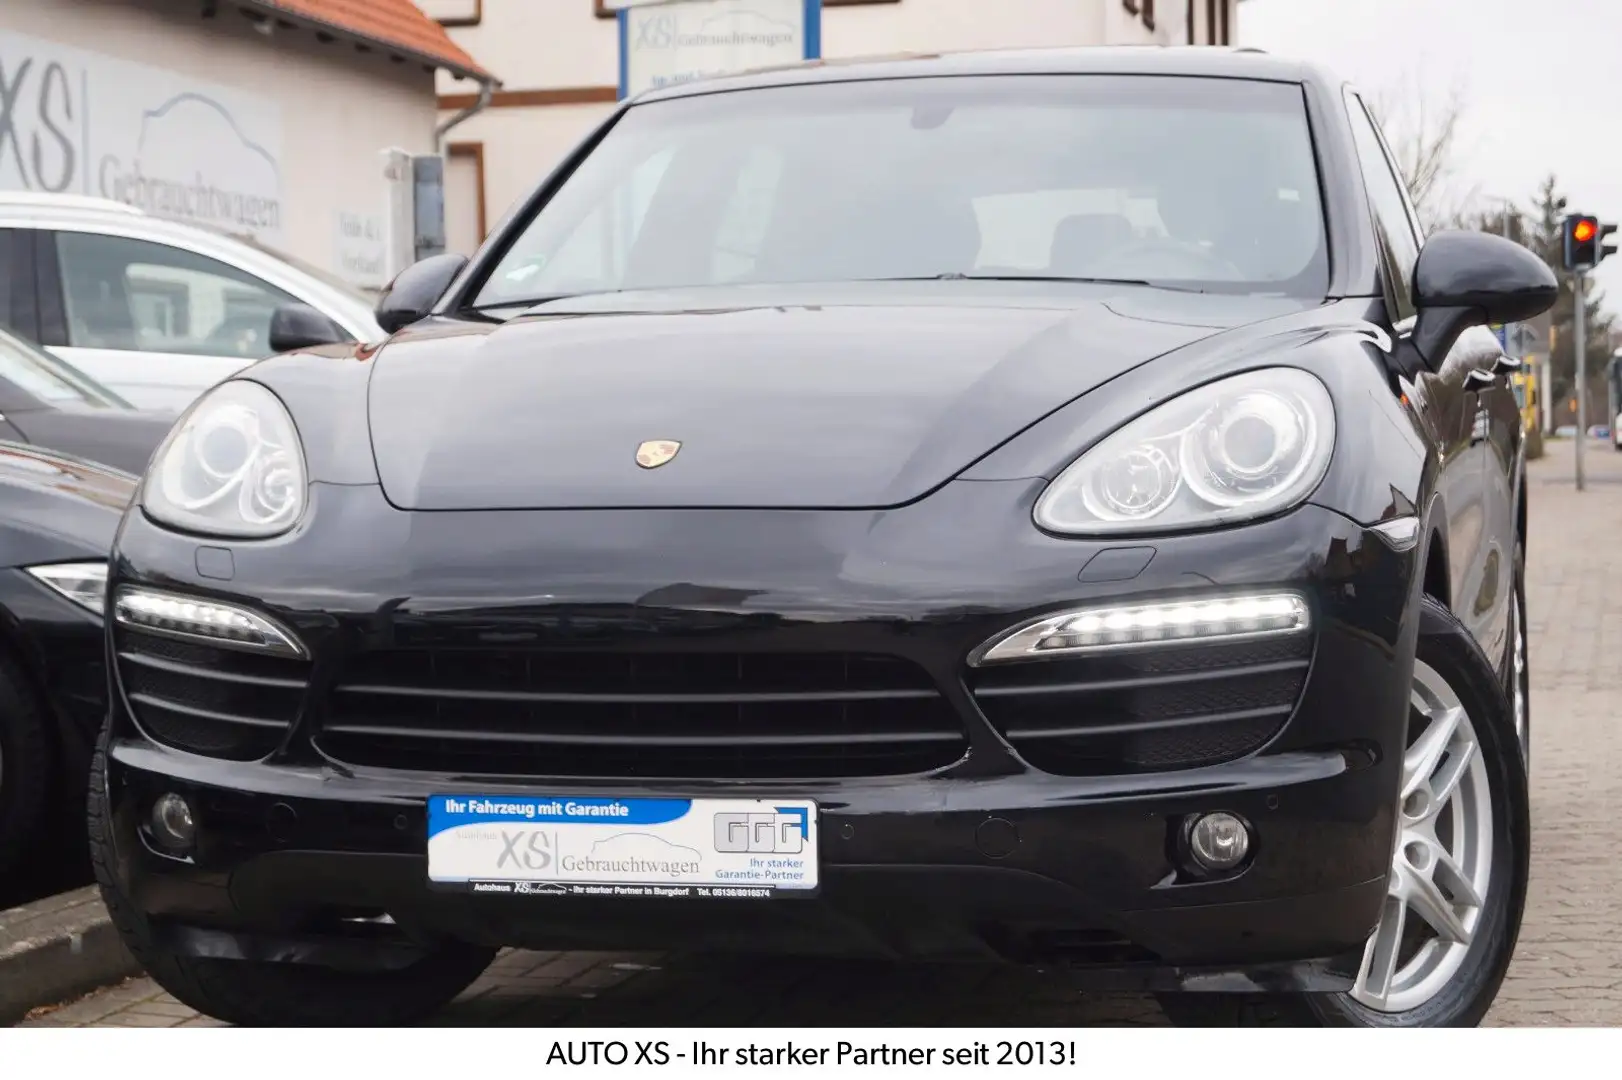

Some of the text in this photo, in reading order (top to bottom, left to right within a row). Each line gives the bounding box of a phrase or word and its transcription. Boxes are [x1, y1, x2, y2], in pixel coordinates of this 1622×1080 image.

[445, 799, 629, 818] Ihr Fahrzeug mit Garantie
[497, 831, 700, 878] XS Gebrauchtwagen
[750, 858, 804, 868] Ihr starker
[715, 869, 804, 880] Garantie-Partner
[474, 883, 511, 892] Autohaus
[573, 885, 584, 893] Ihr
[586, 886, 613, 894] starker
[614, 886, 643, 895] Partner
[645, 887, 652, 895] in
[654, 887, 690, 897] Burgdorf
[697, 888, 711, 896] Tel.
